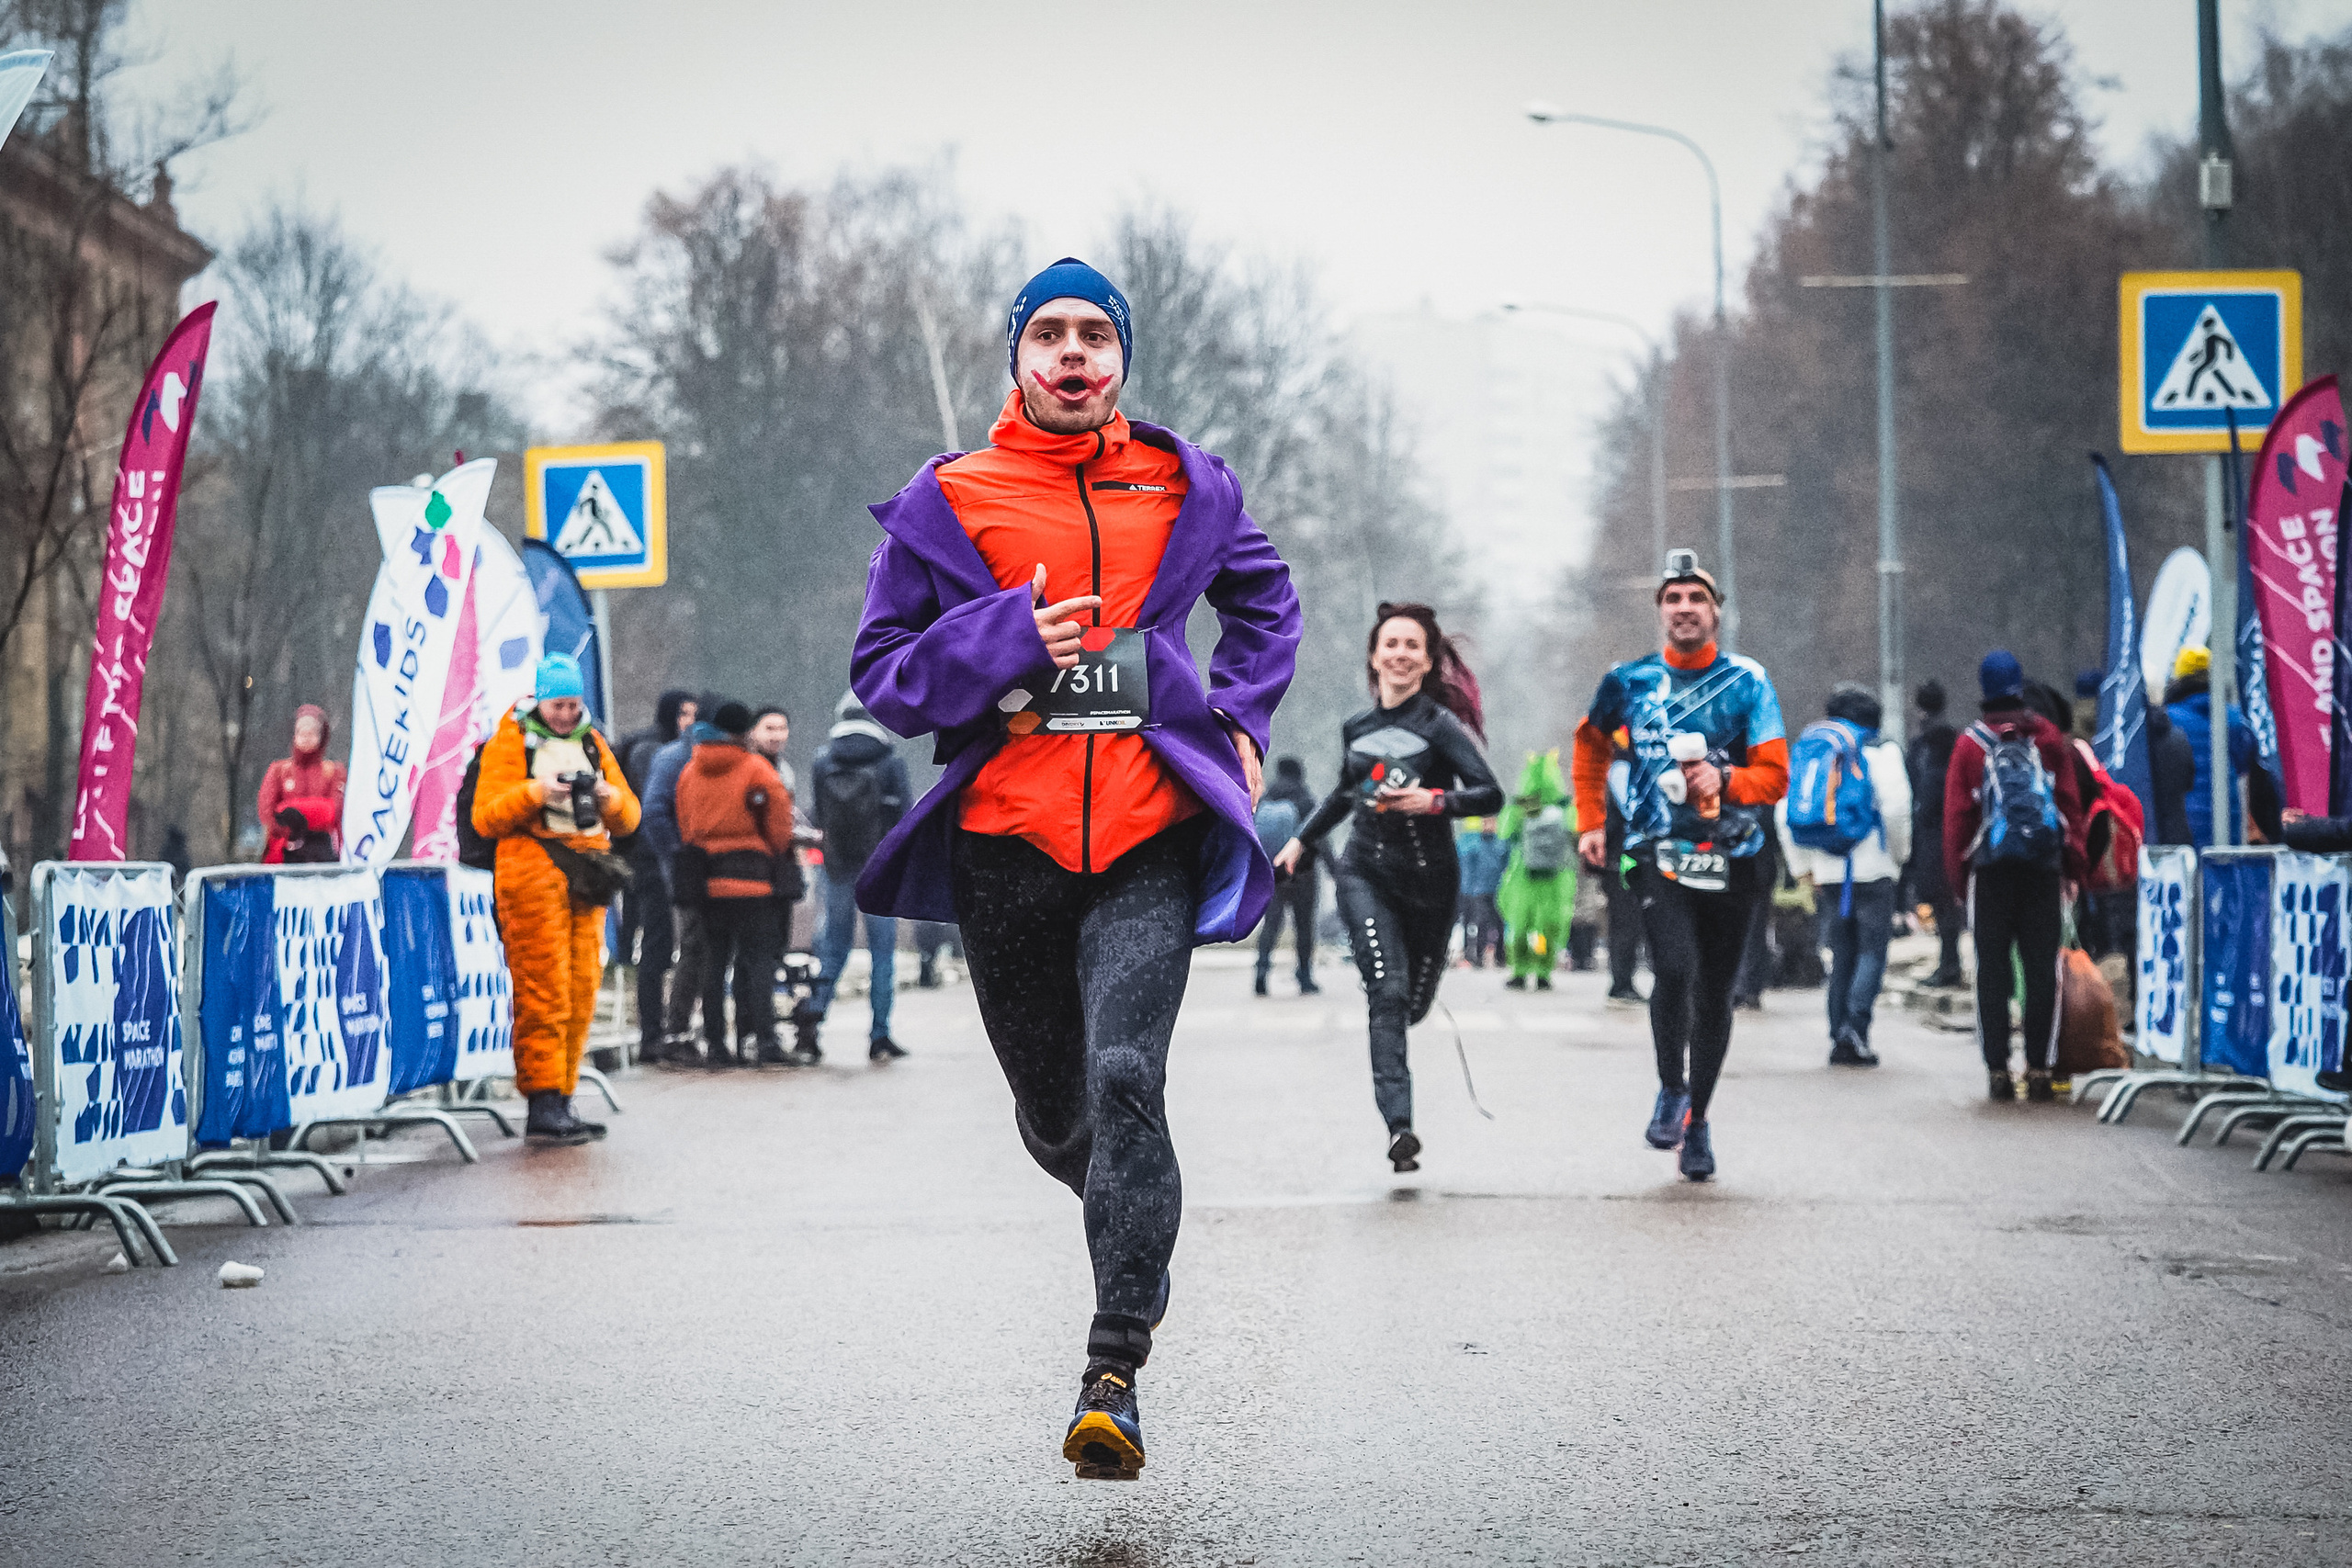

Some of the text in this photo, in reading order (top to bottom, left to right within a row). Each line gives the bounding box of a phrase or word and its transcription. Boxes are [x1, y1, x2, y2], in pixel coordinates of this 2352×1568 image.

[2278, 513, 2331, 633] SPACE
[354, 616, 426, 862] PACEKIDS
[1679, 853, 1724, 873] 7292
[1110, 1375, 1127, 1388] ASICS
